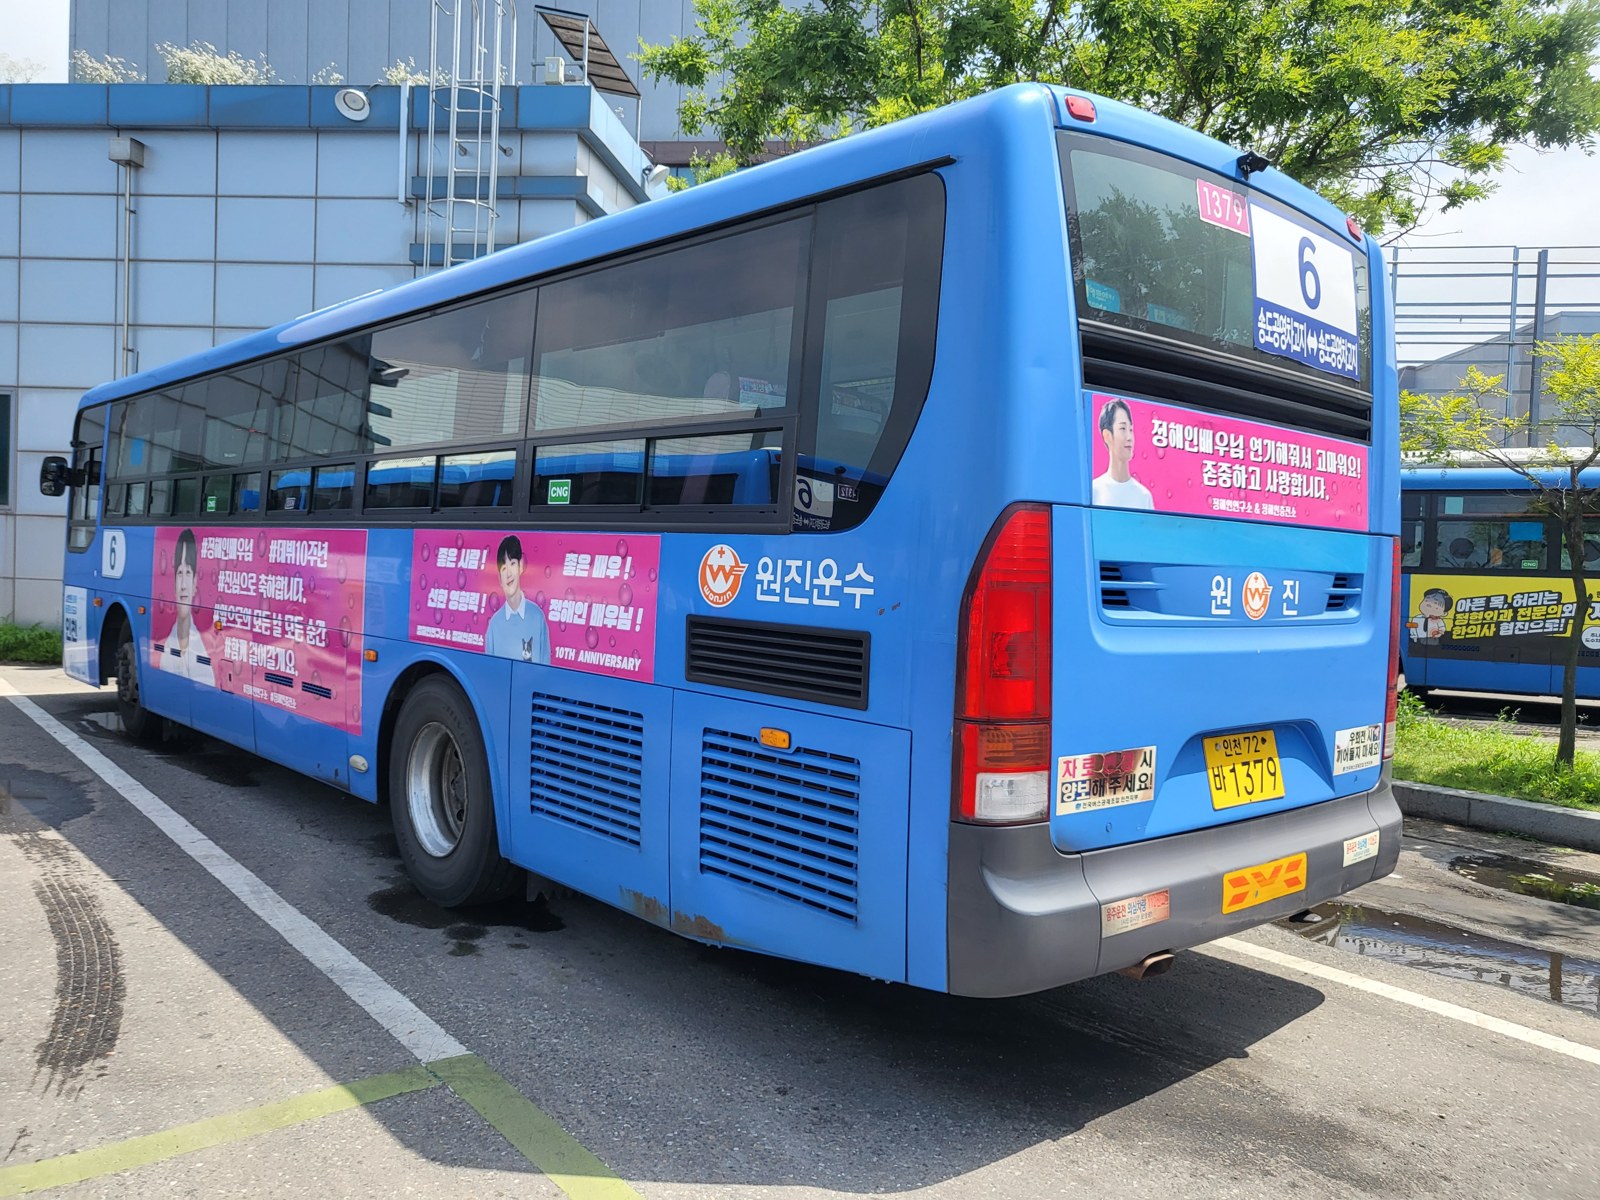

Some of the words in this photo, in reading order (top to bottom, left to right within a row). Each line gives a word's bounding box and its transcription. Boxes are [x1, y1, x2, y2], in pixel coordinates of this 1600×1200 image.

[1203, 187, 1243, 225] 1379
[1297, 236, 1321, 310] 6
[1257, 306, 1307, 358] 송도공영차고지
[1318, 328, 1358, 376] 송도공영차고지
[1151, 419, 1245, 460] 정해인배우님
[1315, 449, 1362, 480] 고마워요!
[550, 486, 569, 497] CNG
[1202, 459, 1262, 491] 존중하고
[1265, 469, 1330, 501] 사랑합니다.
[1254, 502, 1260, 514] &
[110, 535, 117, 570] 6
[436, 547, 458, 568] 좋은
[562, 553, 591, 577] 좋은
[217, 570, 256, 596] #진심으로
[258, 573, 307, 604] 축하합니다.
[755, 556, 875, 609] 원진운수
[1210, 575, 1232, 615] 원
[1282, 579, 1300, 616] 진
[548, 598, 589, 625] 정해인
[1454, 609, 1513, 626] 정형외과
[1456, 597, 1487, 612] 아픈
[1489, 595, 1509, 609] 목,
[1512, 591, 1559, 607] 허리는
[1452, 623, 1496, 640] 한의사
[1499, 618, 1565, 636] 협진으로!
[555, 646, 576, 661] 10TH
[578, 649, 642, 672] ANNIVERSARY
[1222, 737, 1243, 757] 인천
[1243, 735, 1261, 754] 72
[1060, 772, 1153, 803] 양보해주세요!
[1211, 765, 1227, 793] 바
[1229, 756, 1277, 798] 1379
